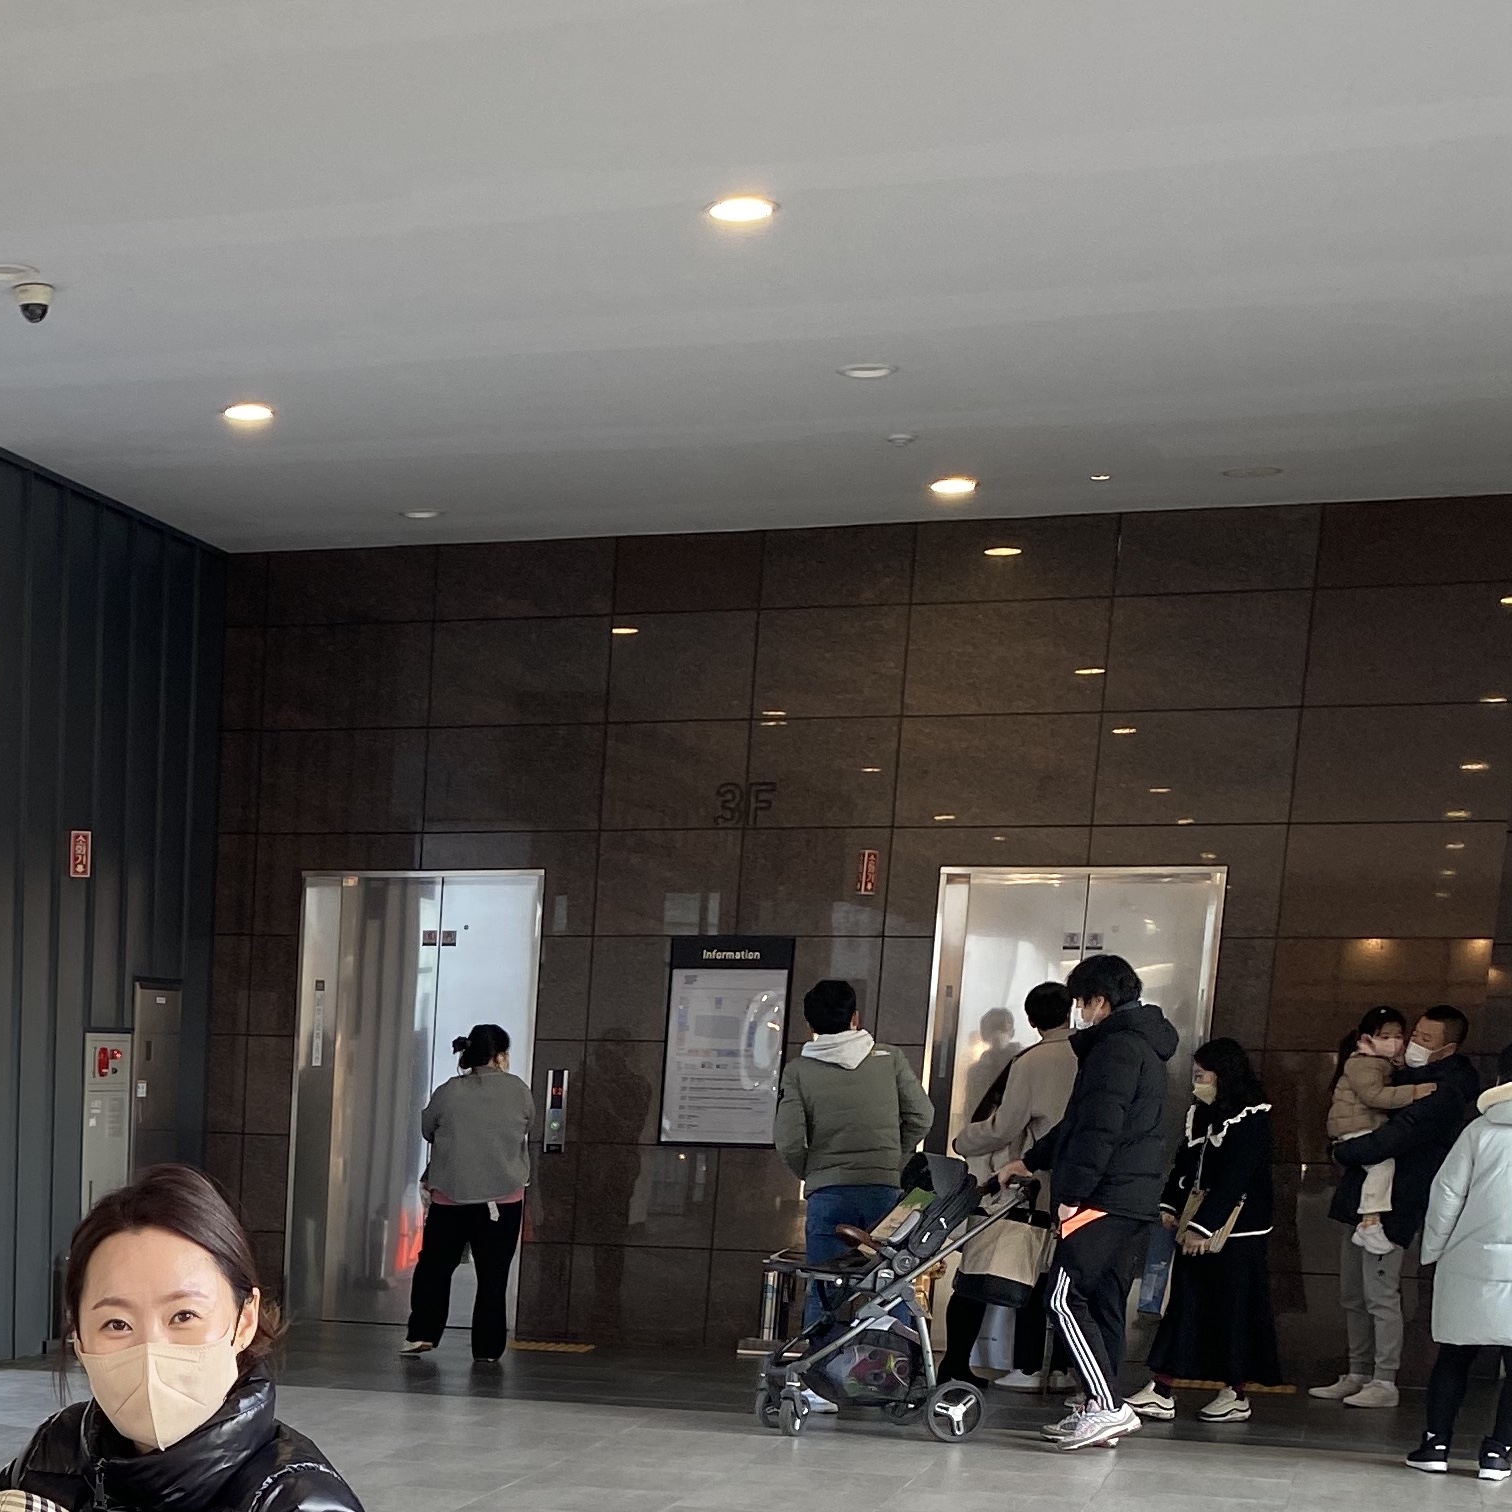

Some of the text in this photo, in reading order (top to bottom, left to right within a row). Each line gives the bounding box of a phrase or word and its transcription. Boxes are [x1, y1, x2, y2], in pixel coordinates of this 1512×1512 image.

[713, 781, 777, 826] 3F
[74, 834, 87, 865] 소화기
[702, 949, 761, 960] Information
